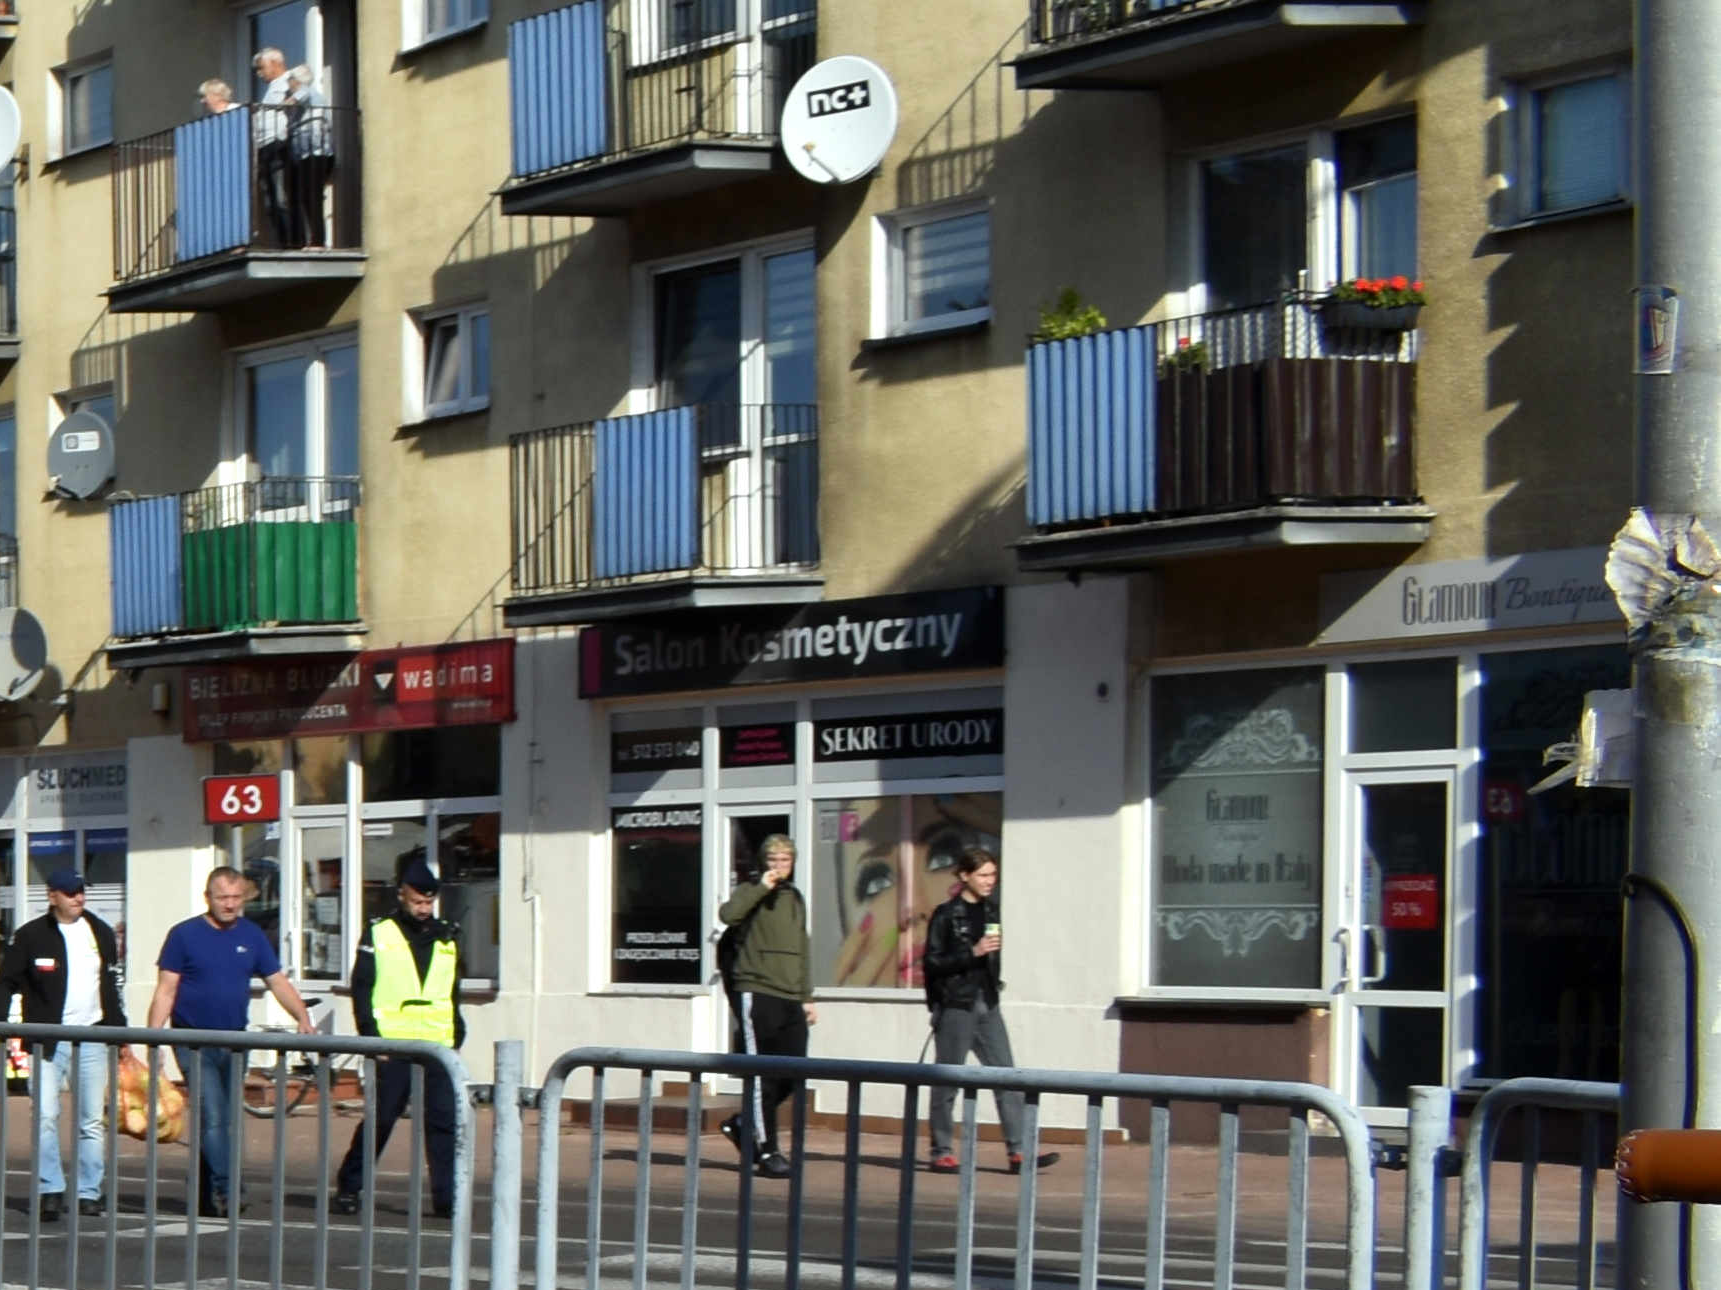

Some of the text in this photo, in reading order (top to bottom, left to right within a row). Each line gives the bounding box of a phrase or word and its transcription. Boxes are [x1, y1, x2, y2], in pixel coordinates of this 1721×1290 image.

[810, 85, 868, 114] nc+
[615, 613, 964, 675] Salon Kosmetyczny
[189, 671, 278, 701] BIELIZNA
[403, 662, 494, 689] wadima
[820, 717, 997, 756] SEKRET URODY
[221, 785, 263, 814] 63
[615, 810, 702, 828] MICROBLADING
